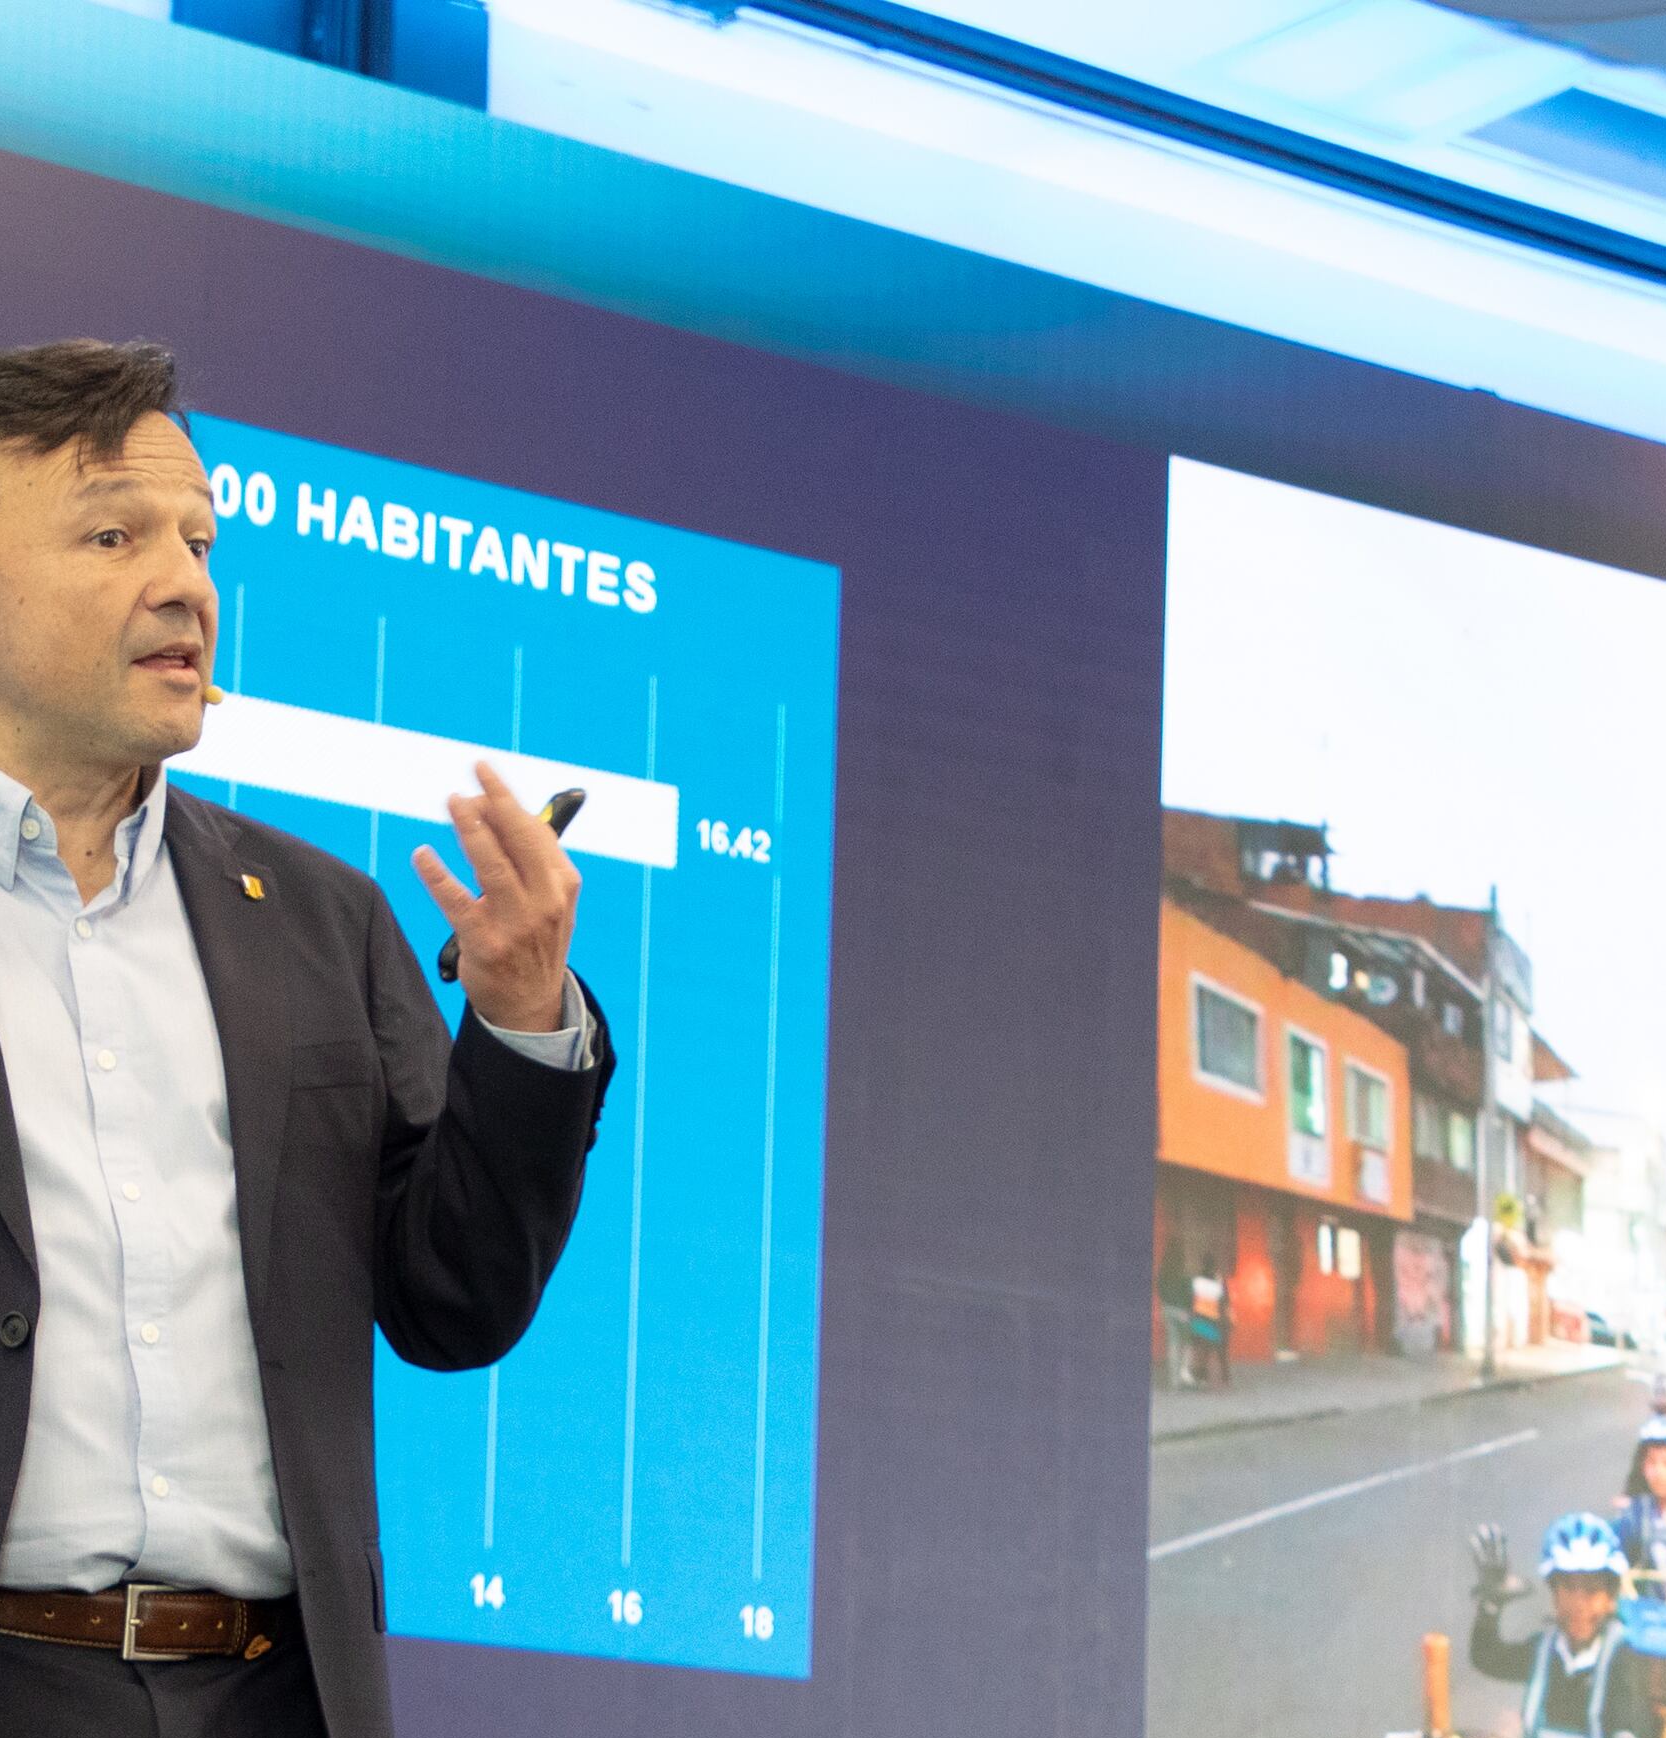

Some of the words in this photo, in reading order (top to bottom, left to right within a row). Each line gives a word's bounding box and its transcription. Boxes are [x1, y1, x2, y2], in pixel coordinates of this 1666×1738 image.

[296, 482, 658, 614] HABITANTES
[696, 818, 771, 863] 16.42
[470, 1573, 506, 1609] 14
[607, 1589, 643, 1626] 16
[739, 1604, 775, 1641] 18
